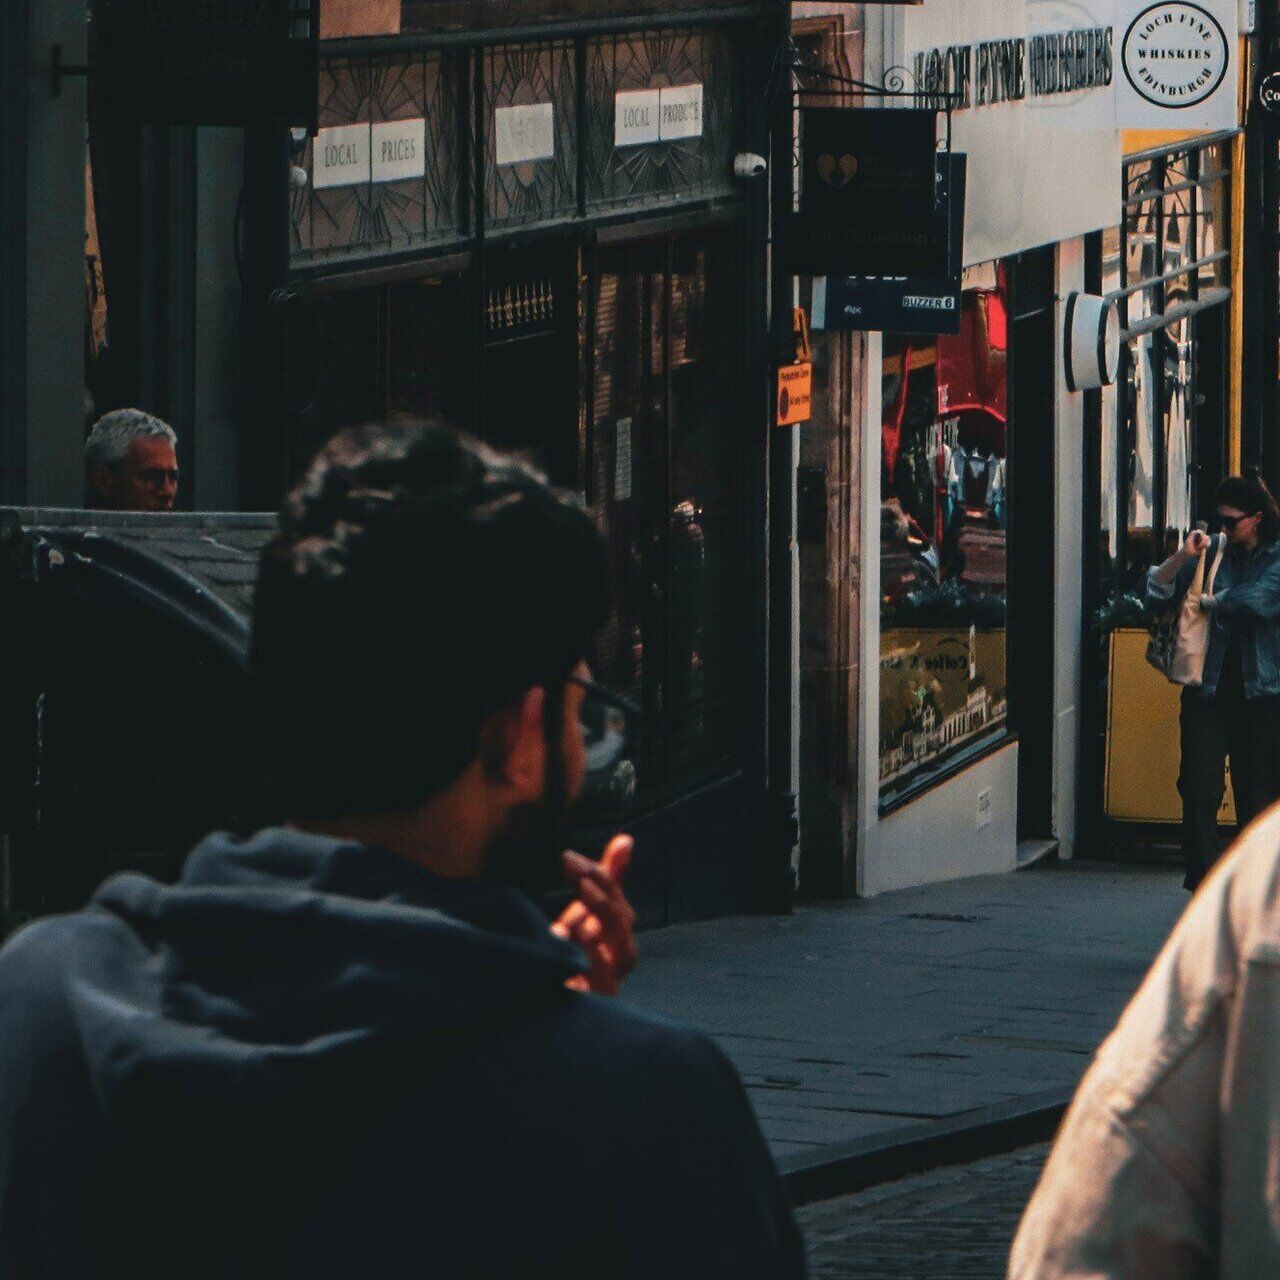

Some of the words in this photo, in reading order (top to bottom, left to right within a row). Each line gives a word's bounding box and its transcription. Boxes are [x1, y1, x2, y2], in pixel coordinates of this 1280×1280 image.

[1139, 13, 1174, 42] LOCH
[1180, 13, 1213, 42] FYNE
[1138, 48, 1212, 60] WHISKIES
[1139, 67, 1213, 96] EDINBURGH
[624, 107, 650, 129] LOCAL
[663, 101, 698, 124] PRODUCE
[324, 142, 358, 168] LOCAL
[381, 140, 416, 163] PRICES
[903, 295, 942, 309] BUZZER
[944, 297, 953, 309] 6
